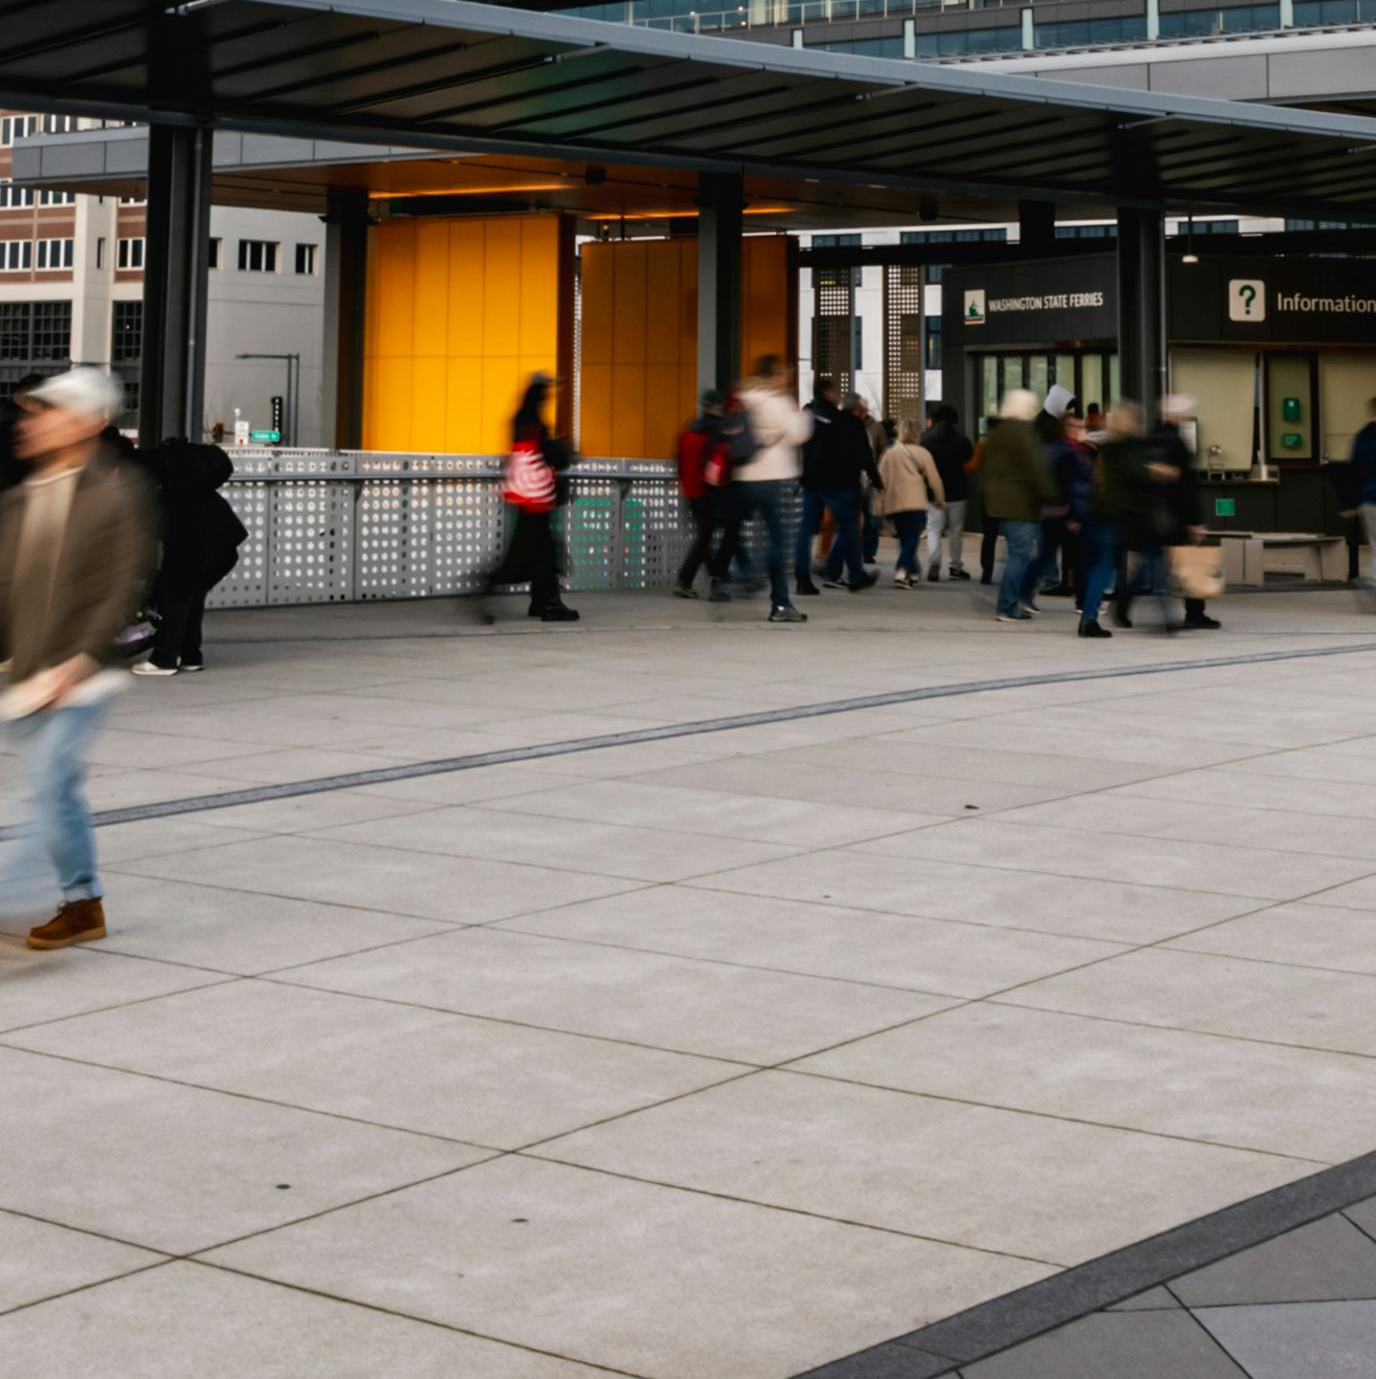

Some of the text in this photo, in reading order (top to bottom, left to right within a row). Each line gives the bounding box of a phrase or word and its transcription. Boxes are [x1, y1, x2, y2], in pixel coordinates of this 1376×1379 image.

[988, 292, 1104, 312] WASHINGTON STATE FERRIES
